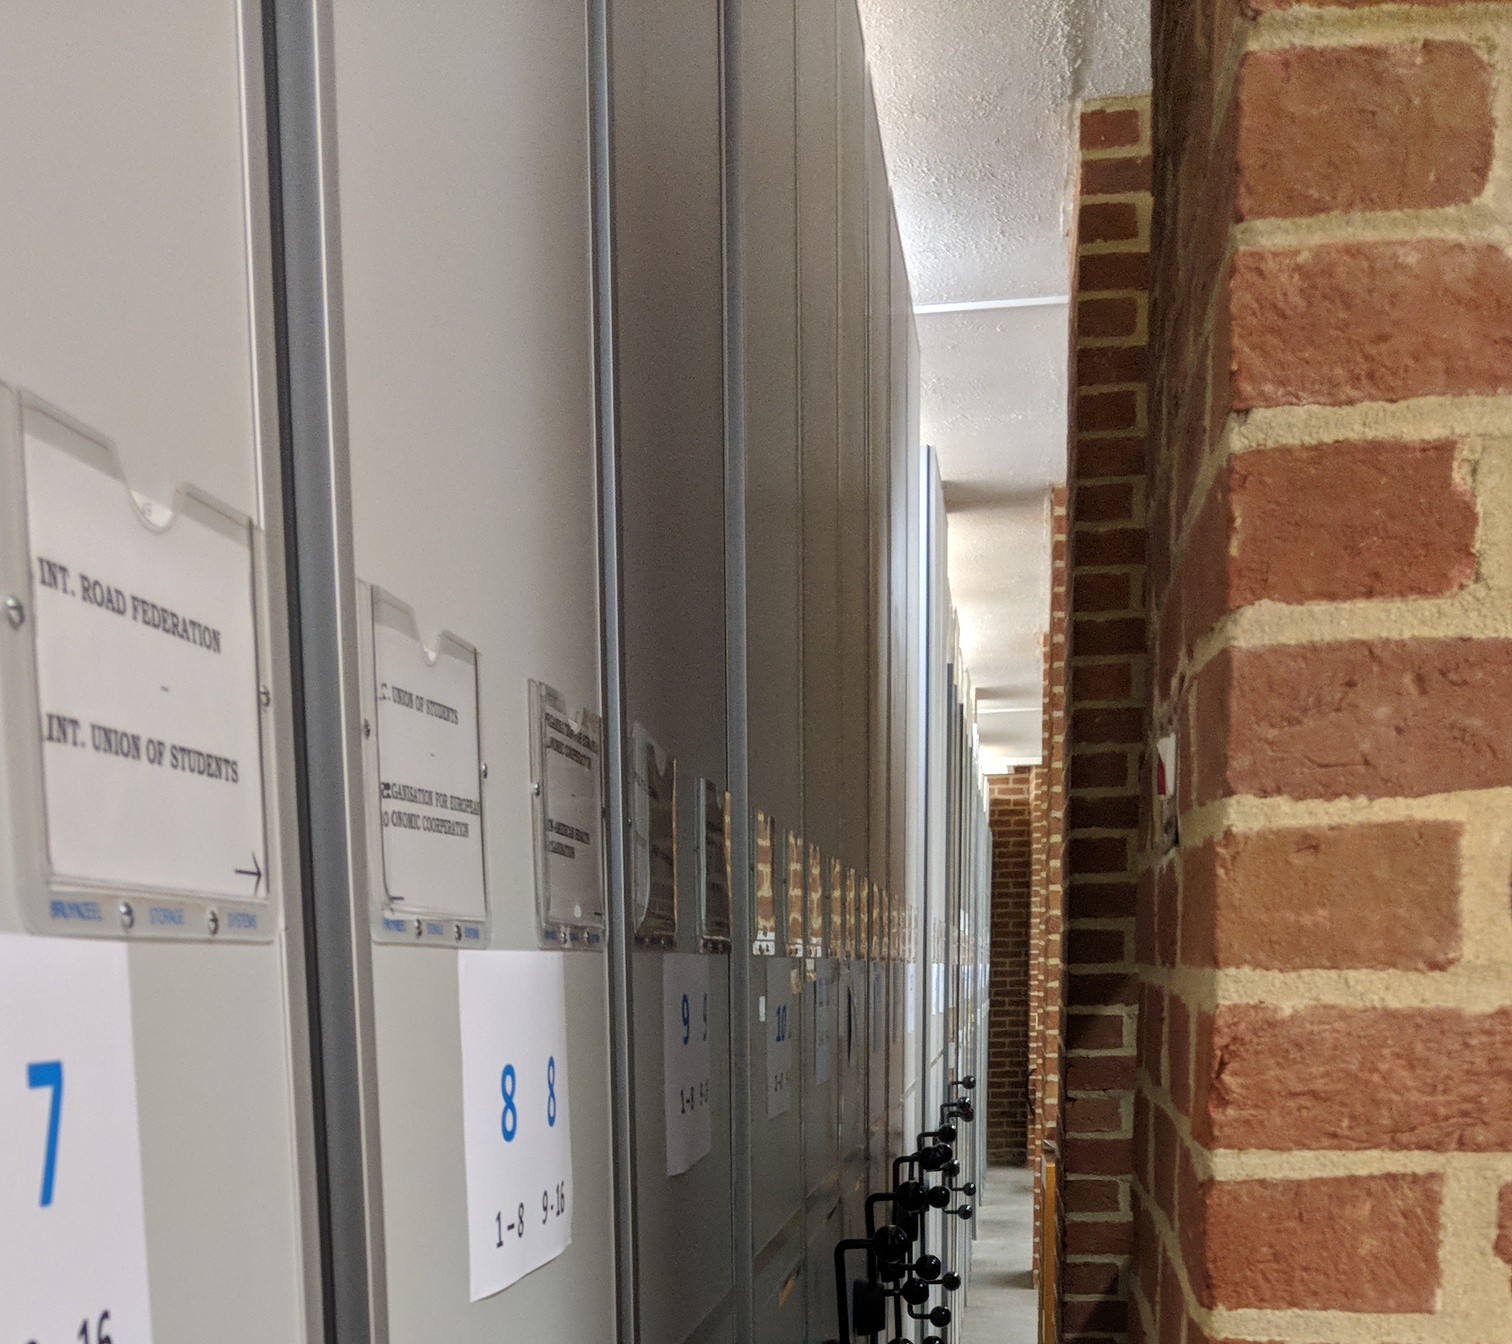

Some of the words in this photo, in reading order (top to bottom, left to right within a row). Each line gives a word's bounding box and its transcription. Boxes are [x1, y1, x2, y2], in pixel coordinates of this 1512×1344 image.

[38, 557, 75, 597] INT.
[79, 573, 127, 615] ROAD
[131, 595, 221, 654] FEDERATION
[391, 685, 414, 710] UNION
[415, 694, 424, 713] OF
[426, 698, 459, 726] STUDENTS
[46, 713, 85, 749] INT.
[90, 723, 140, 760] UNION
[146, 738, 165, 767] OF
[170, 745, 239, 784] STUDENTS
[435, 791, 449, 809] FOR
[681, 993, 690, 1045] 9
[501, 1063, 517, 1142] 8
[547, 1055, 556, 1127] 8
[27, 1059, 63, 1207] 7
[542, 1180, 565, 1226] 9-16
